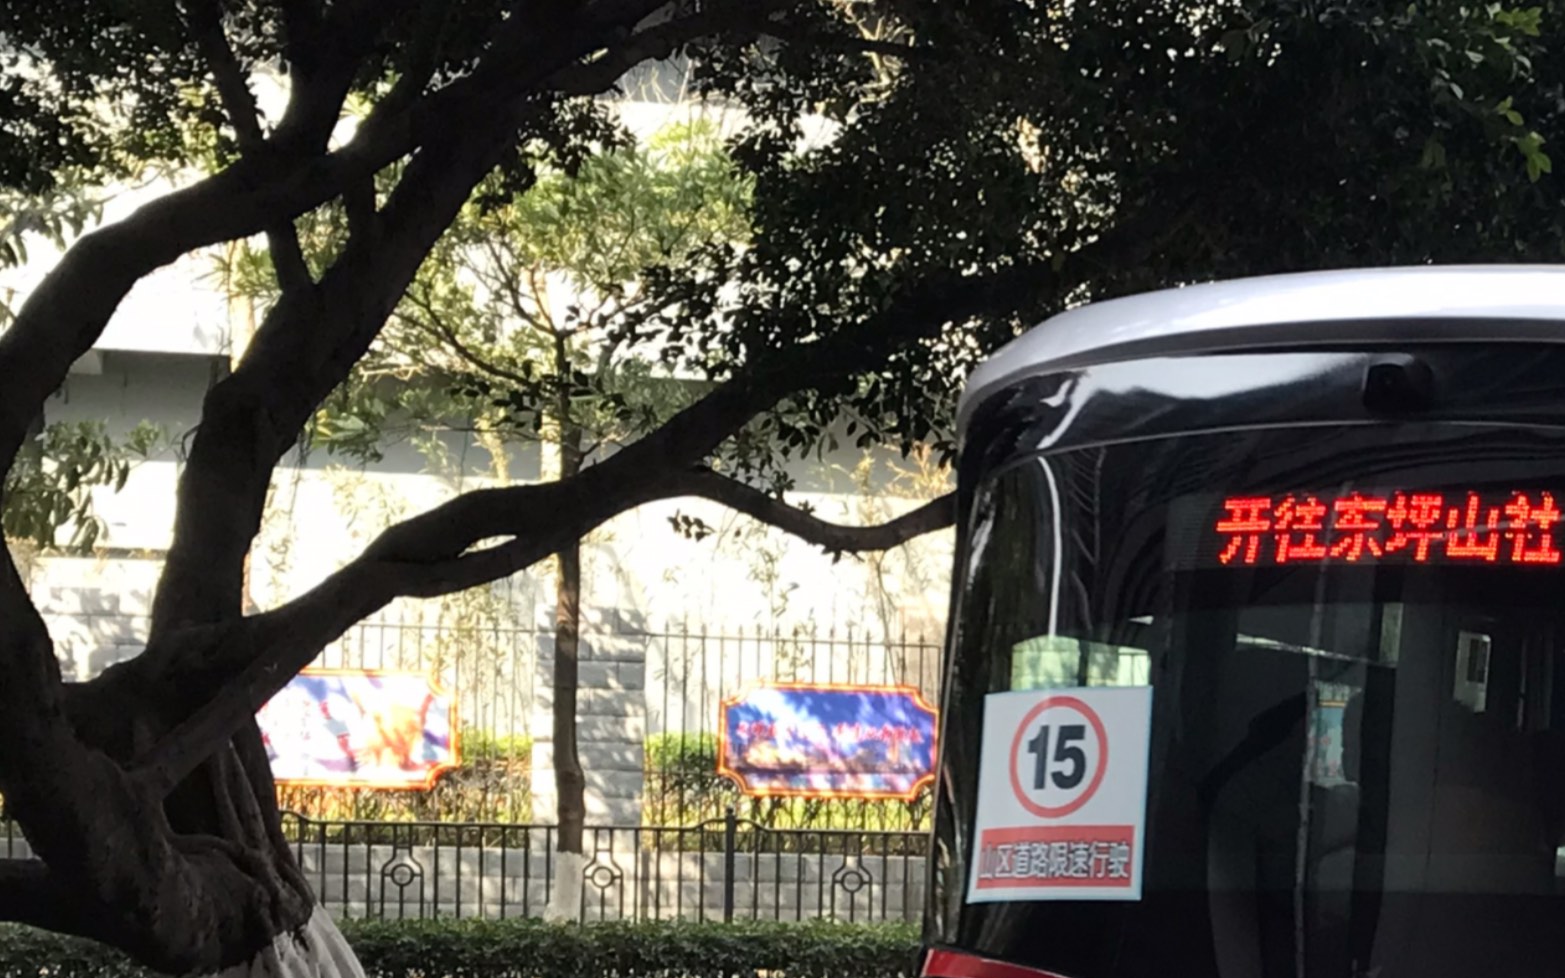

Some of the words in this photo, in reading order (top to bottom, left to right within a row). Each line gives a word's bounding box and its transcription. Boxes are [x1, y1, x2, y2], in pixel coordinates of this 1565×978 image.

[1215, 490, 1562, 564] 开往东坪山社
[1026, 723, 1087, 791] 15
[978, 840, 1130, 880] 山区道路限速行驶
